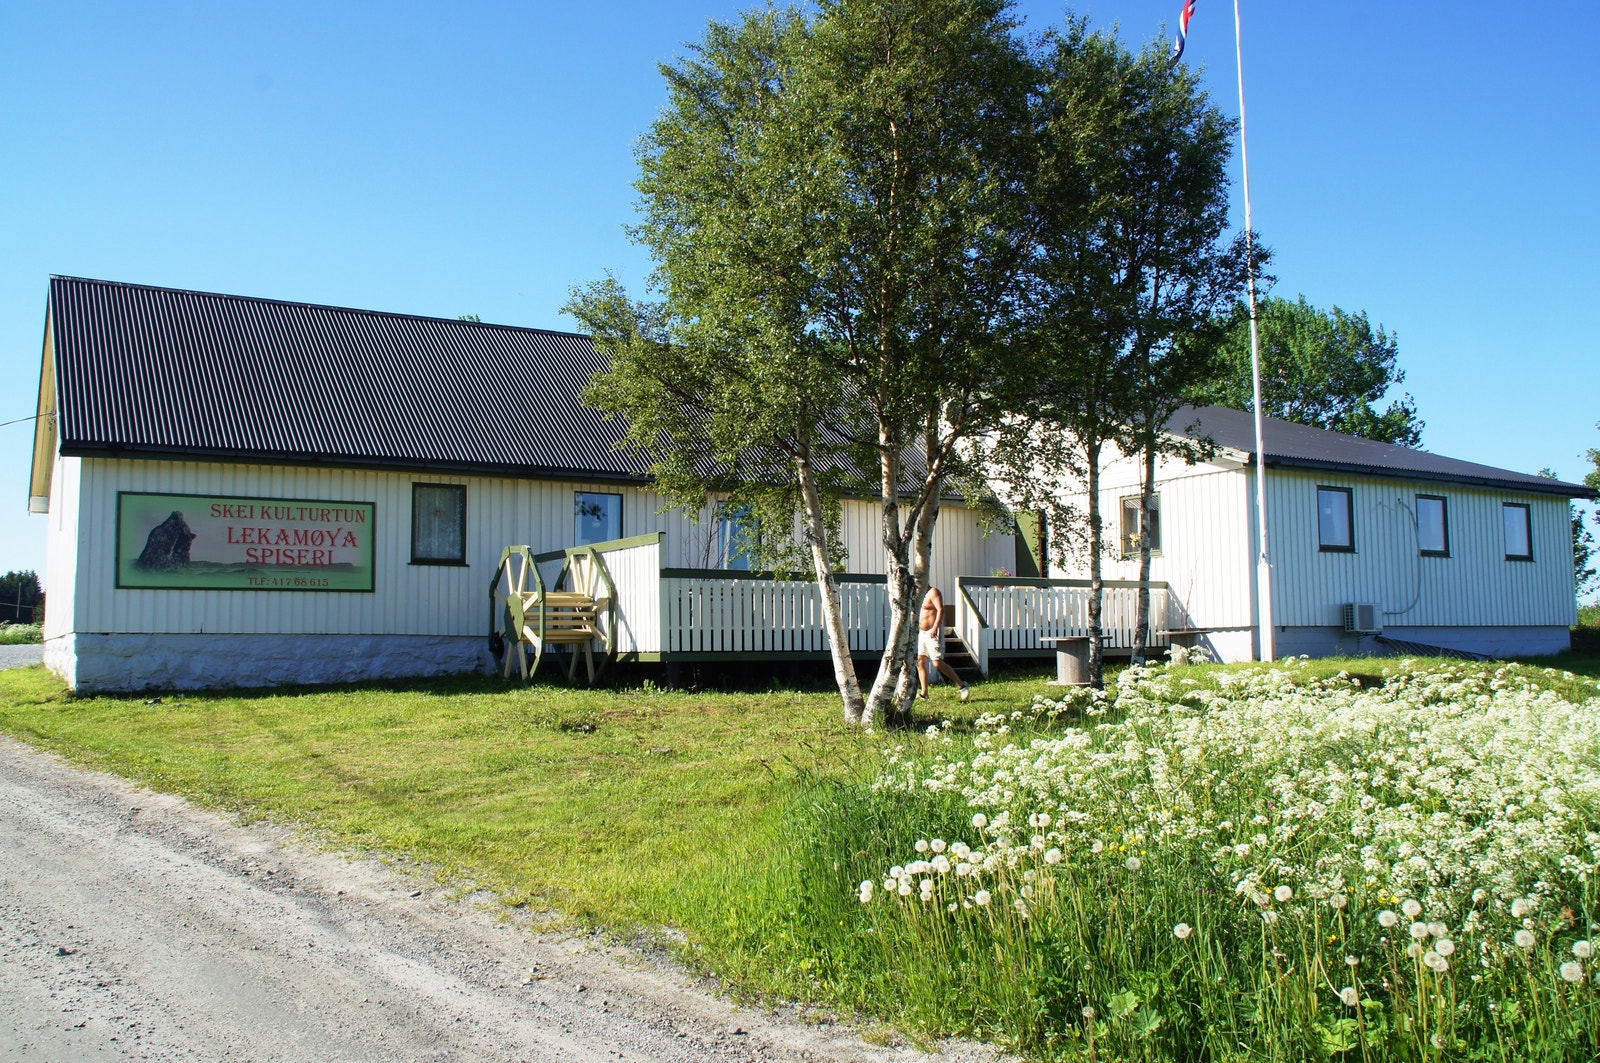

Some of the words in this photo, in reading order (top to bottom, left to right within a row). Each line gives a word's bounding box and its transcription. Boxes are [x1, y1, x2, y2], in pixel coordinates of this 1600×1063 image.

[210, 503, 255, 519] SKEI
[260, 505, 366, 523] KULTURTUN
[227, 526, 359, 548] LEKAMØYA
[245, 547, 334, 567] SPISERI
